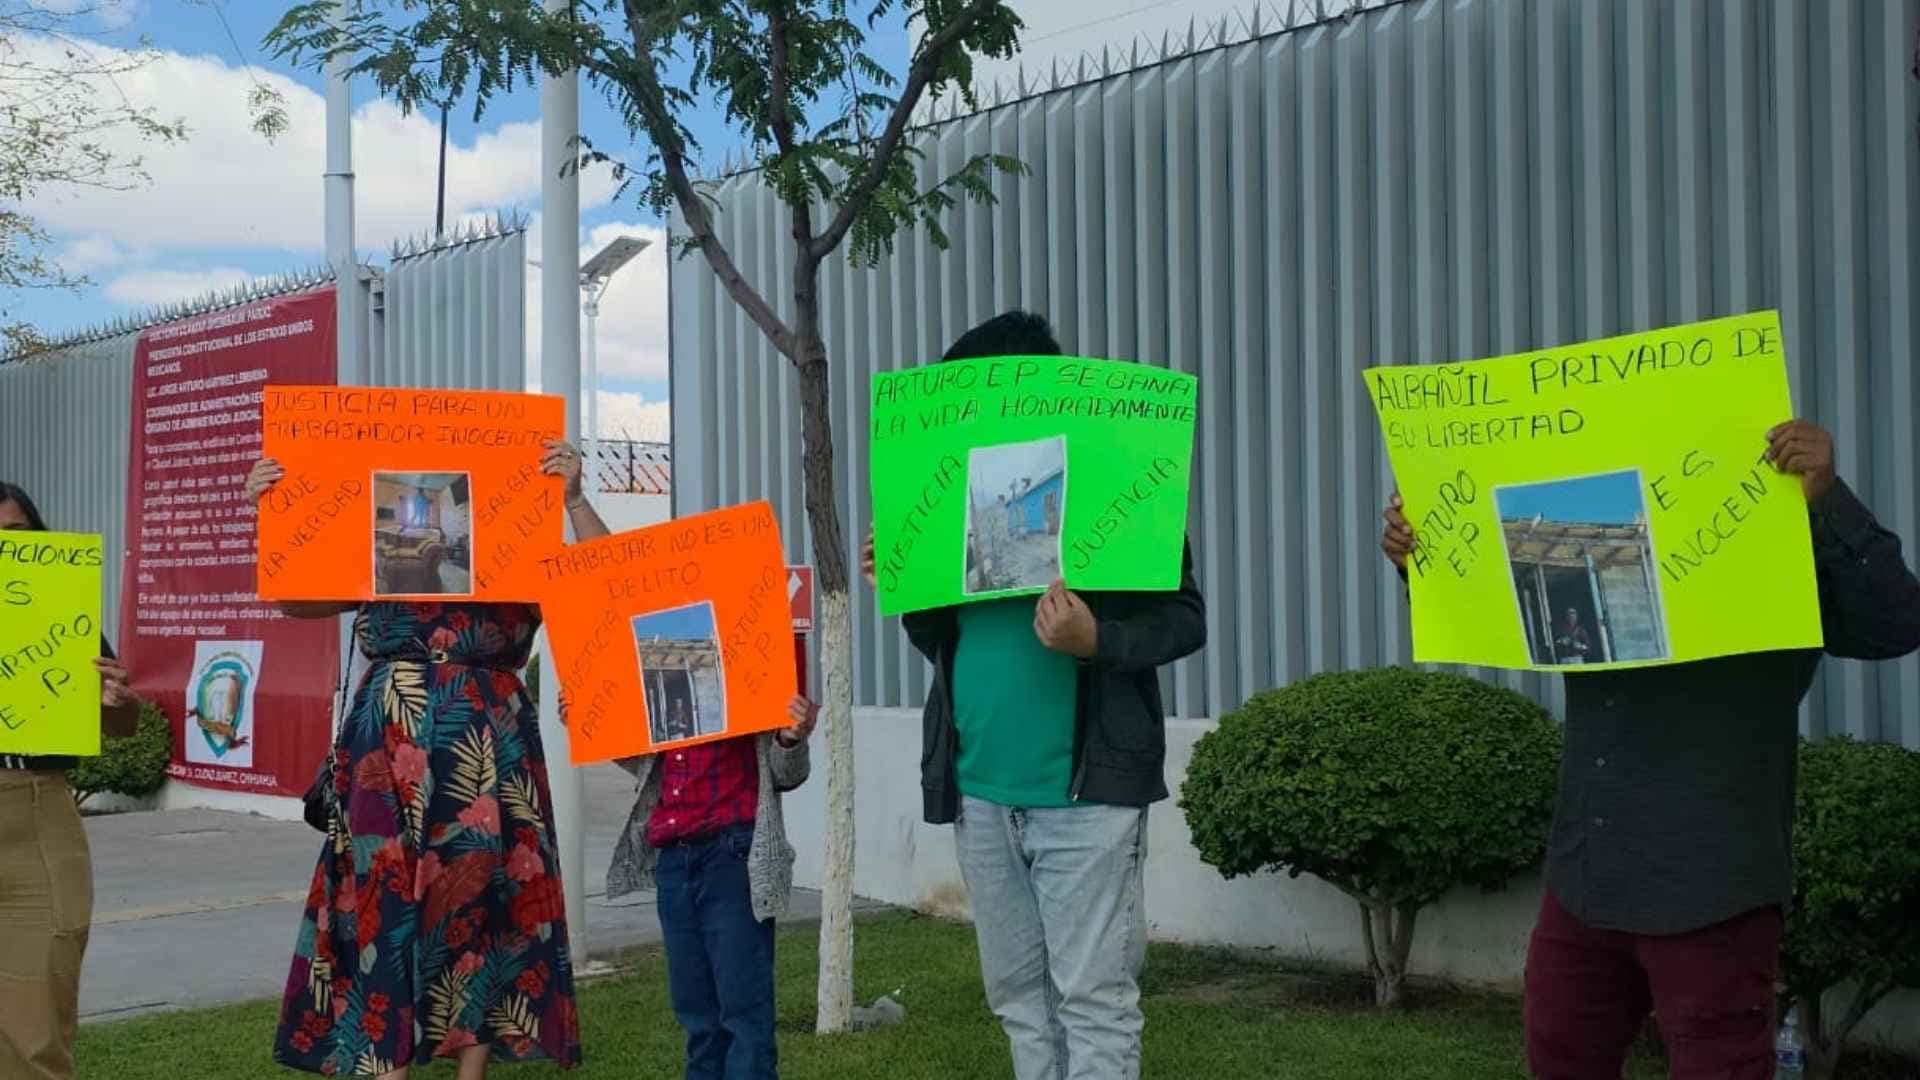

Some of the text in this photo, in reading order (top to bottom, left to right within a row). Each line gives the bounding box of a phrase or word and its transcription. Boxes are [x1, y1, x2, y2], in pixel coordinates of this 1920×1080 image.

[875, 364, 977, 405] ARTURO
[1057, 363, 1097, 388] SE
[1105, 370, 1191, 397] GANA
[1376, 326, 1777, 411] ALBAÑIL PRIVADO DE
[264, 391, 397, 416] JUSTICIA
[412, 394, 480, 417] PARA
[485, 397, 526, 418] UN
[267, 420, 425, 443] TRABAJADOR
[437, 425, 560, 446] INOCENTE
[873, 395, 1194, 441] LA VIDA HONRADAMENTE
[1388, 409, 1585, 449] SU LIBERTAD
[268, 473, 319, 514] QUE
[478, 463, 535, 526] SALGA
[880, 453, 962, 593] JUSTICIA
[1071, 455, 1179, 571] JUSTICIA
[1411, 469, 1477, 579] ARTURO
[1660, 450, 1778, 581] INOCENT
[264, 478, 362, 578] LA VERDAD
[475, 564, 495, 589] A
[513, 489, 555, 539] LUZ
[537, 516, 771, 580] TRABAJAR NO ES UN
[607, 561, 701, 600] DELITO
[724, 566, 776, 667] ARTURO
[562, 609, 622, 704] JUSTICIA
[580, 679, 618, 741] PARA
